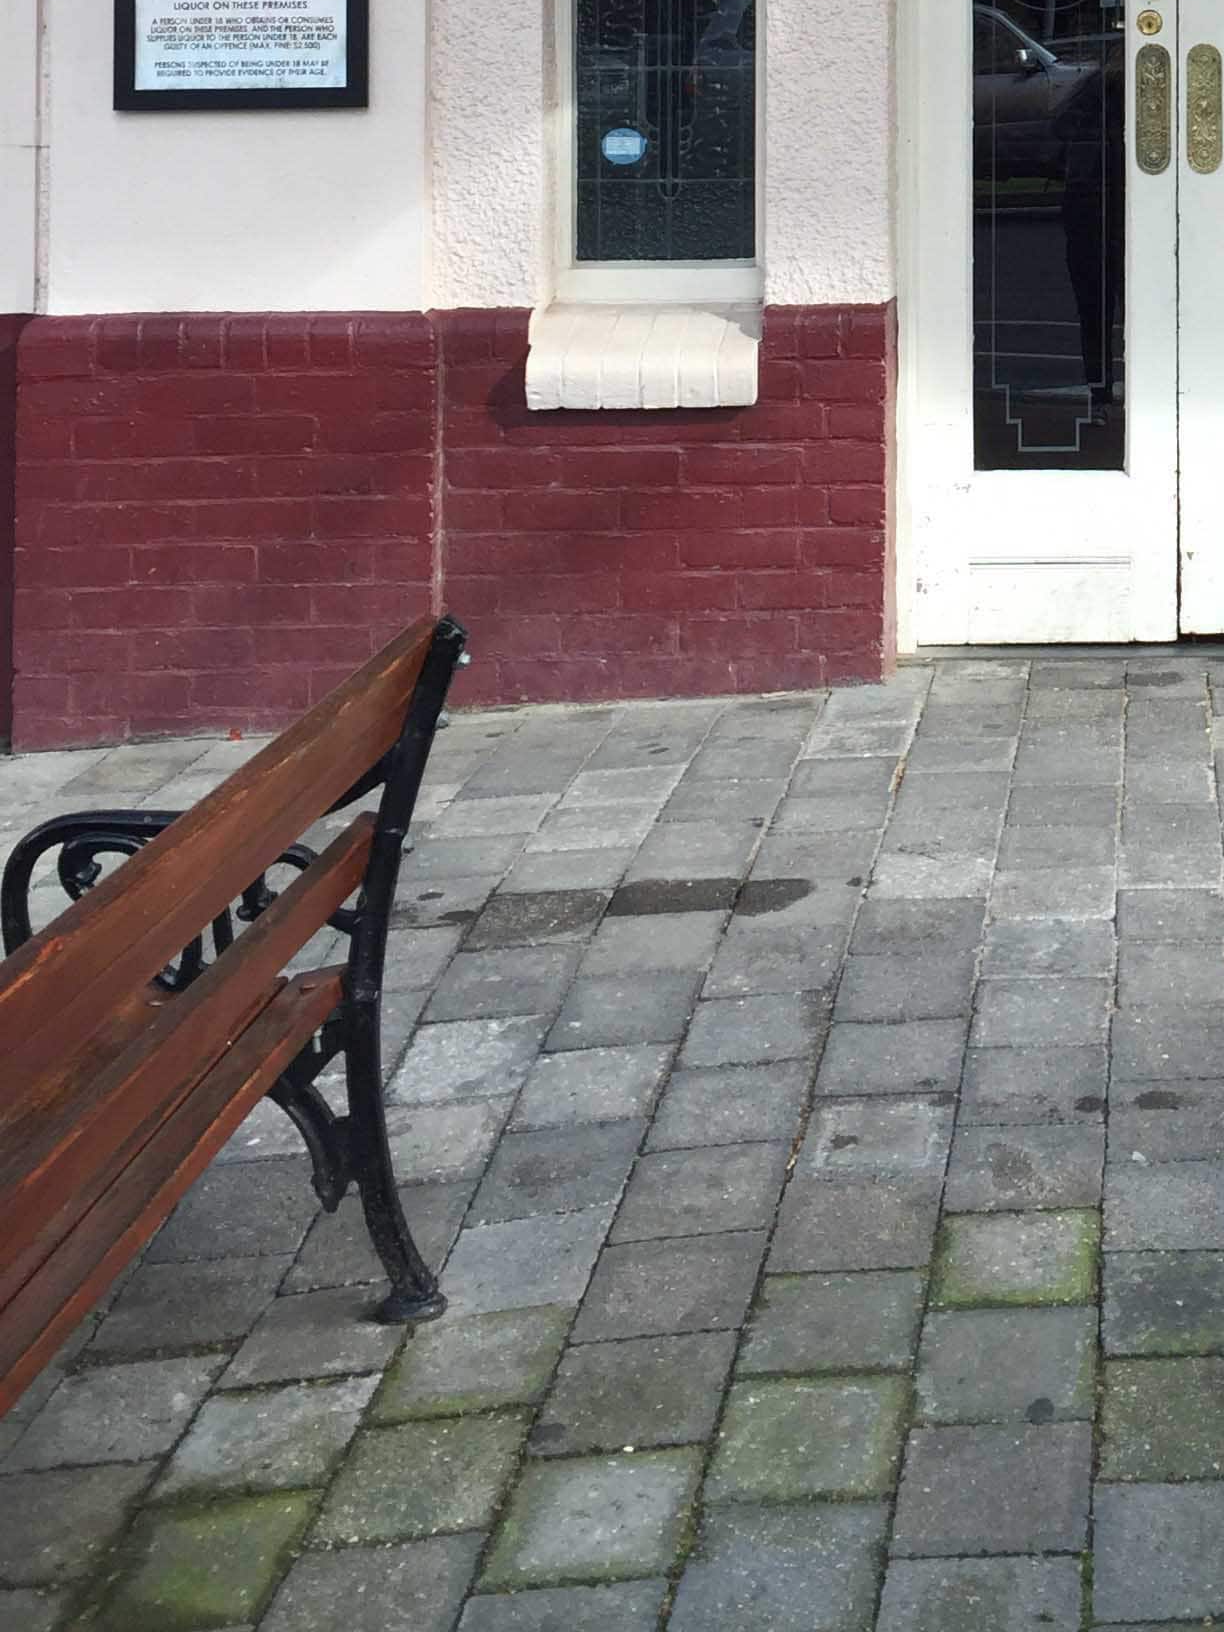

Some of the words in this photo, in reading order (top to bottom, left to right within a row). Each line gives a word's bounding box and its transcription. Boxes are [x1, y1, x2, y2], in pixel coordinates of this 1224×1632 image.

[174, 1, 209, 10] LIQUOR
[213, 1, 229, 9] ON
[232, 0, 260, 9] THESE
[262, 0, 308, 9] PREMISES
